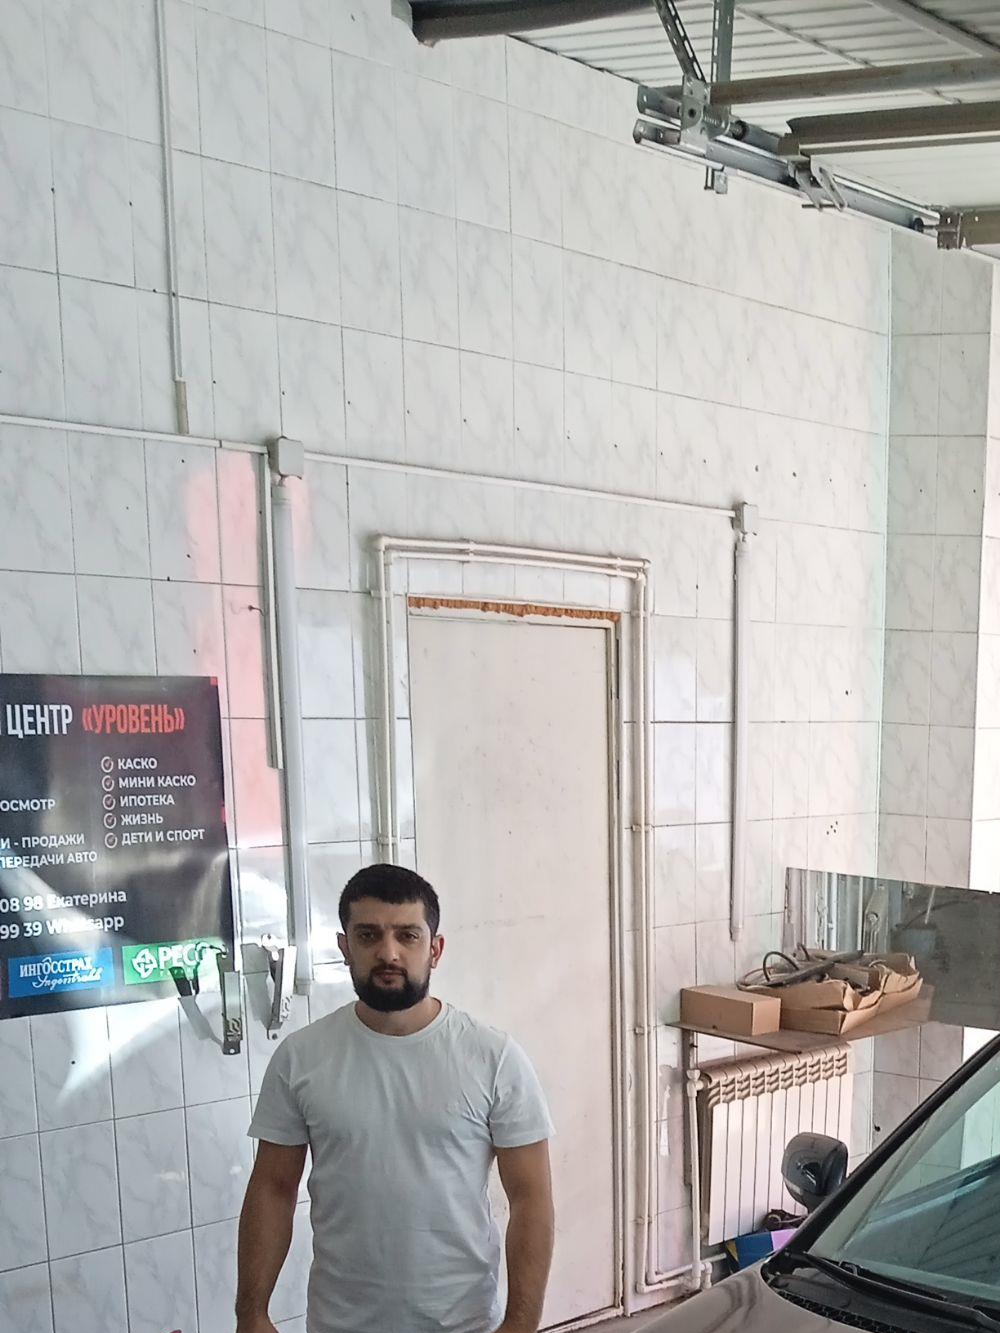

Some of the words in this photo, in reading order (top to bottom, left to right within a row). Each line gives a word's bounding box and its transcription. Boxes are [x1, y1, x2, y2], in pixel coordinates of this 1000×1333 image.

[5, 703, 74, 739] ЦЕНТР
[81, 703, 186, 734] «УРОВЕНЬ»
[117, 757, 158, 770] КАСКО
[118, 776, 155, 789] МИНИ
[157, 774, 197, 787] КАСКО
[0, 798, 56, 811] ОСМОТР
[120, 794, 175, 807] ИПОТЕКА
[120, 812, 164, 826] ЖИЗНЬ
[22, 832, 85, 849] ПРОДАЖИ
[121, 831, 153, 847] ДЕТИ
[155, 830, 164, 843] И
[166, 828, 206, 842] СПОРТ
[66, 850, 98, 864] АВТО
[0, 897, 20, 913] 08
[23, 894, 43, 911] 98
[46, 890, 128, 910] Екатерина
[0, 923, 20, 940] 99
[23, 920, 43, 938] 39
